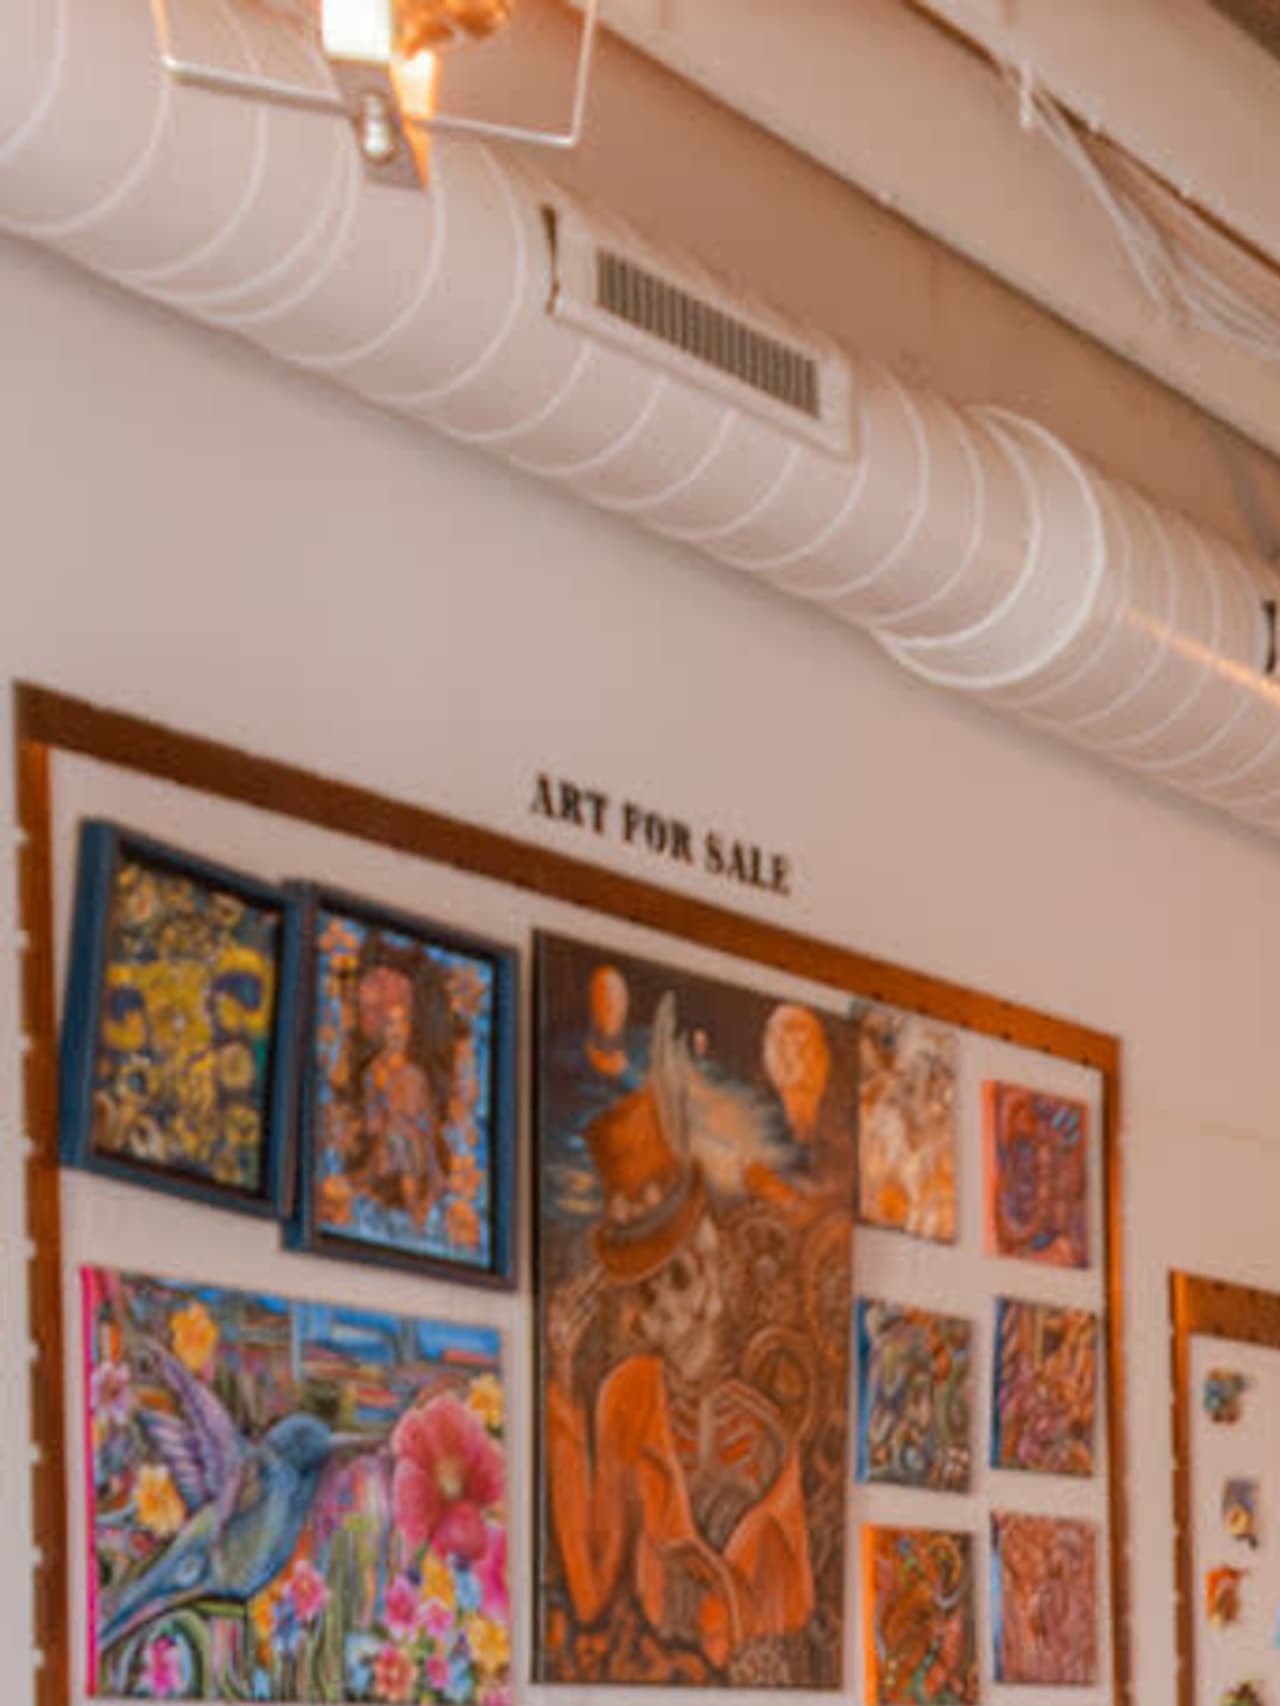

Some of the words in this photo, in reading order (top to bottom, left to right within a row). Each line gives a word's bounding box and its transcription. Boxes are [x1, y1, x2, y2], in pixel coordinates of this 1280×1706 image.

[531, 771, 608, 836] ART
[623, 800, 694, 865] FOR
[704, 830, 791, 896] SALE
